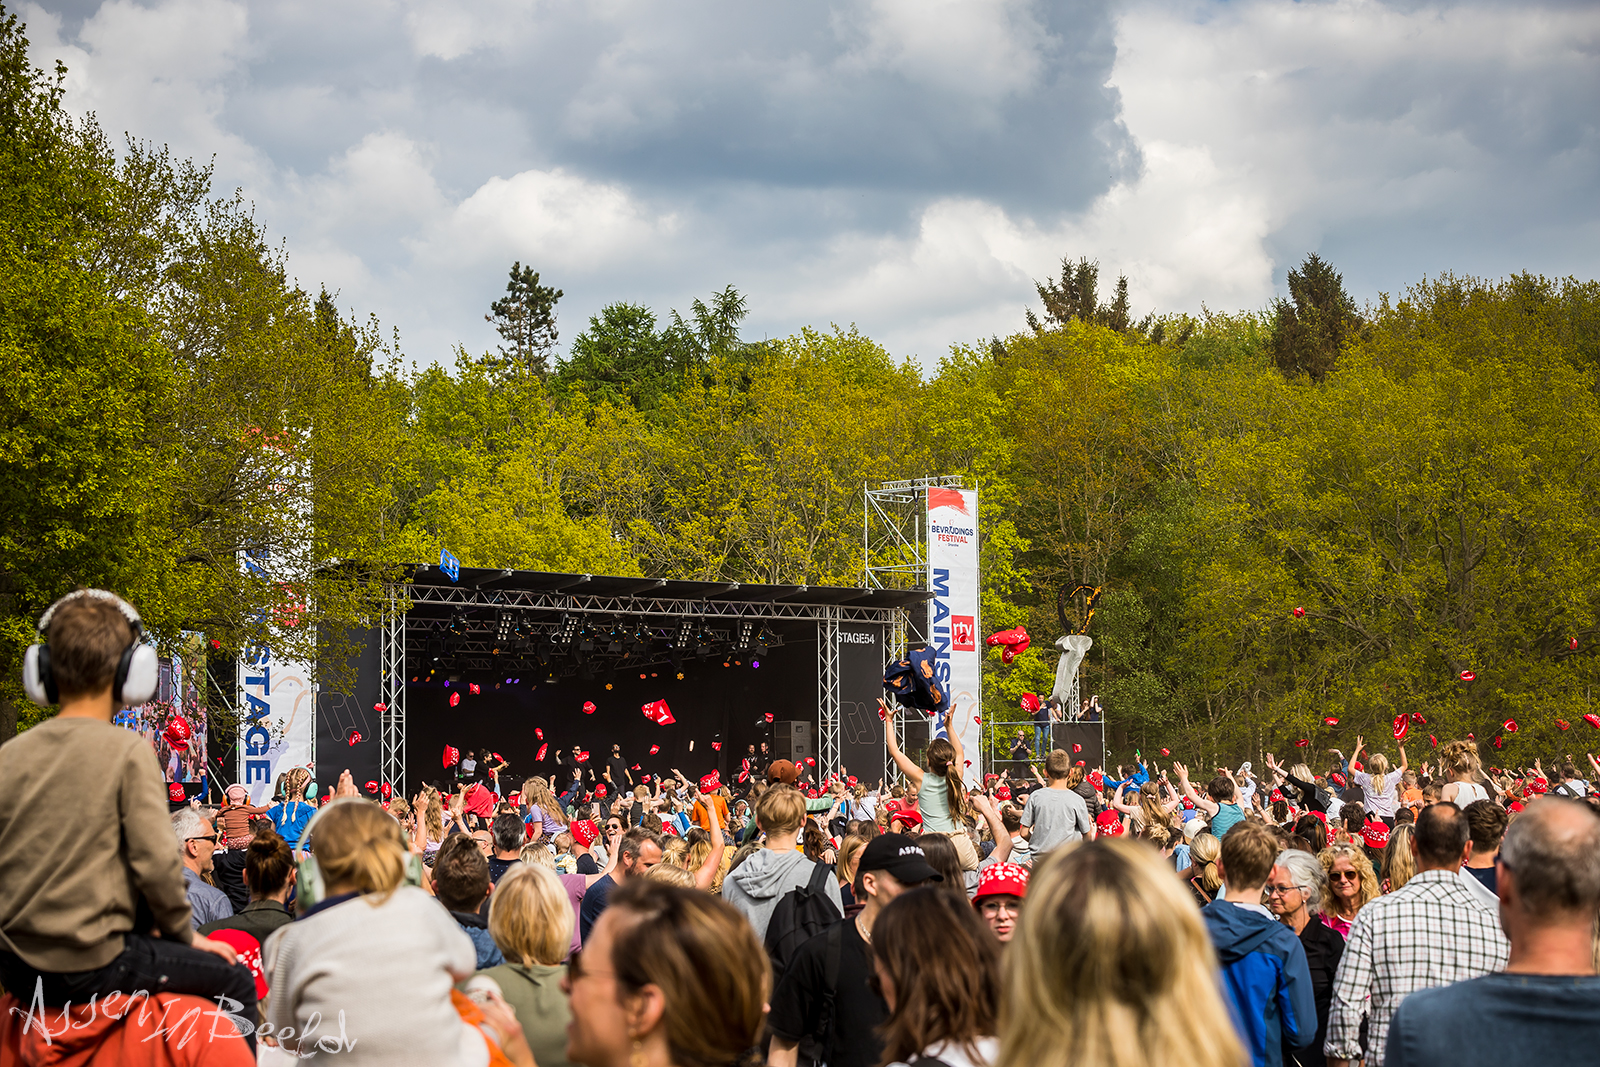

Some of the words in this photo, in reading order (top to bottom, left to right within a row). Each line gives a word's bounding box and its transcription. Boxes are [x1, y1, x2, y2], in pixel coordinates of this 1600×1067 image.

[937, 533, 969, 544] FESTIVAL
[952, 621, 973, 637] rtv
[838, 632, 875, 645] STAGE54
